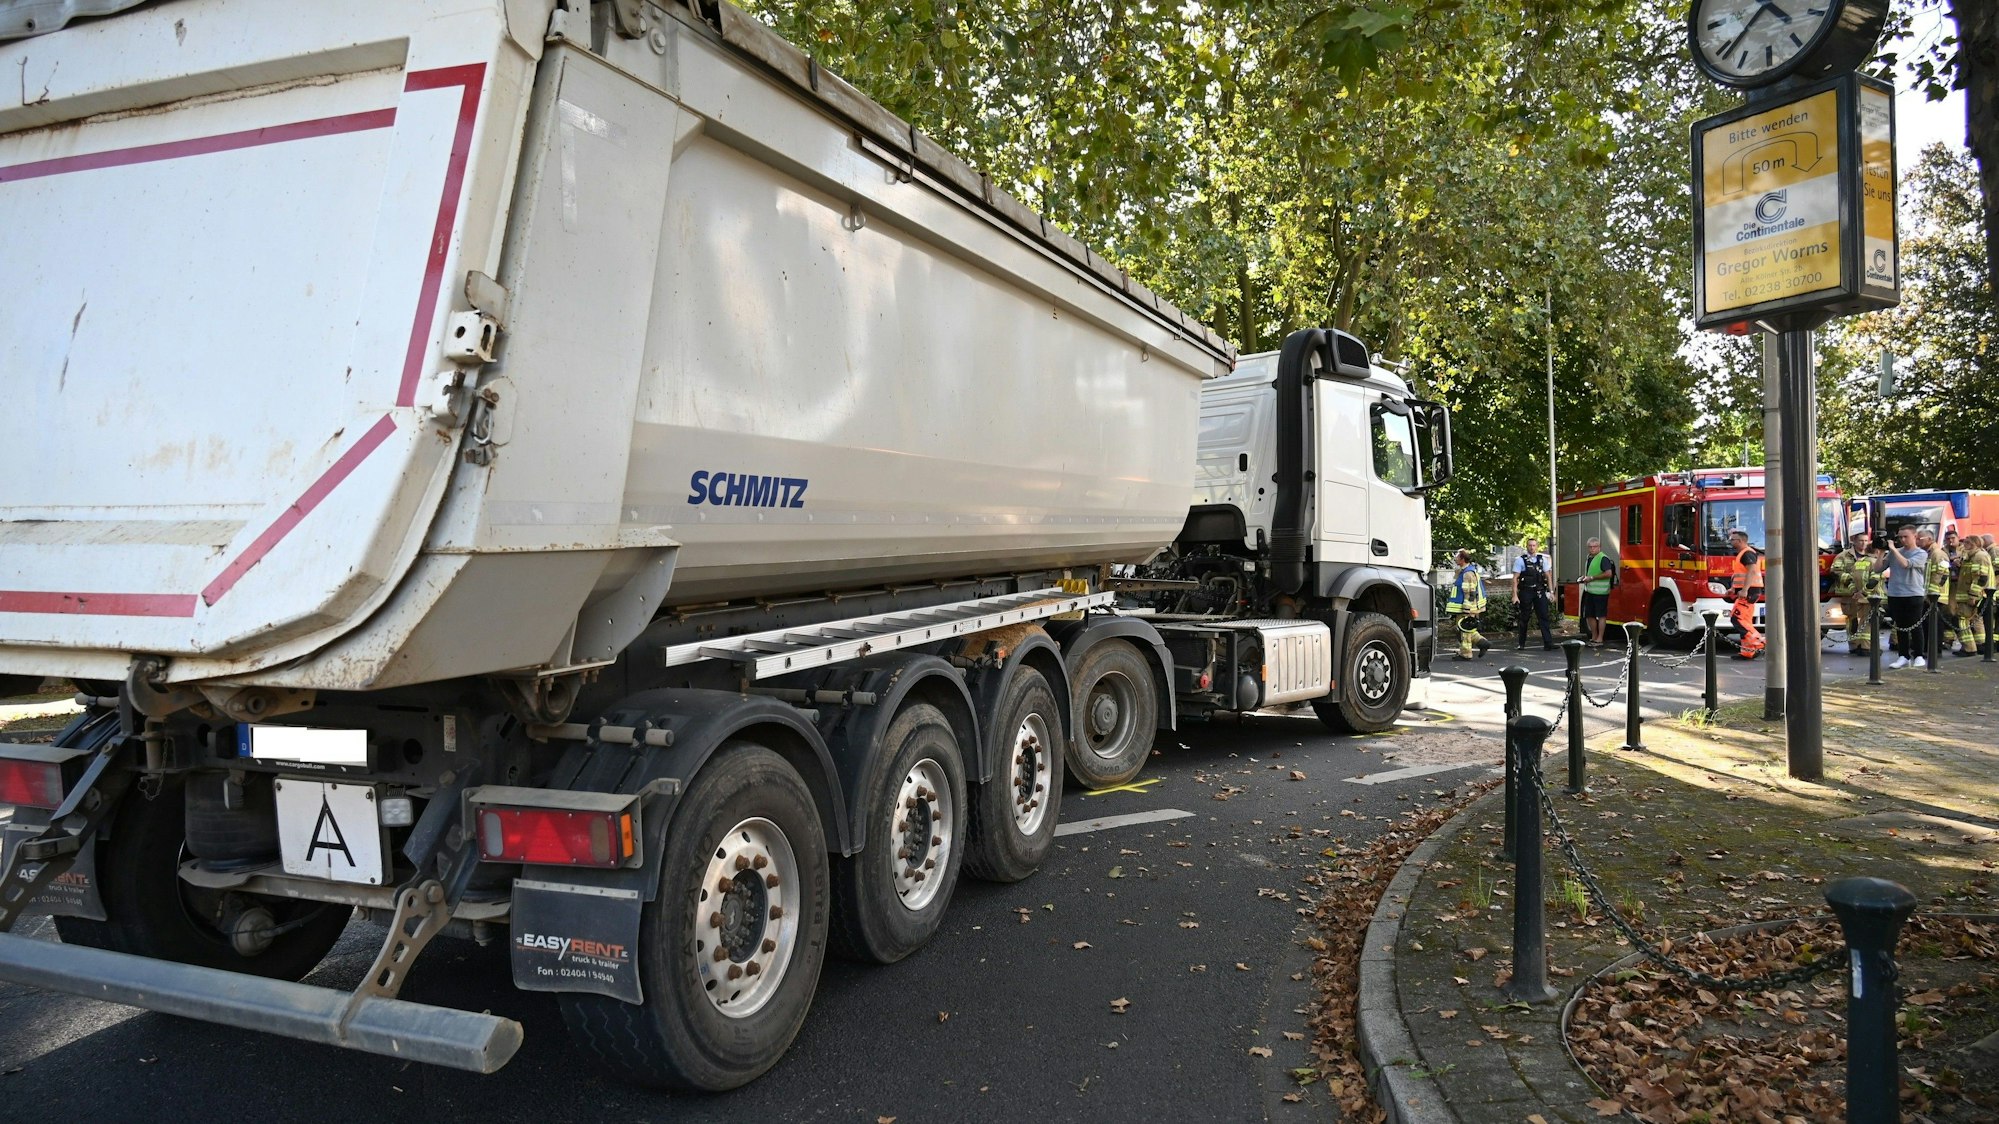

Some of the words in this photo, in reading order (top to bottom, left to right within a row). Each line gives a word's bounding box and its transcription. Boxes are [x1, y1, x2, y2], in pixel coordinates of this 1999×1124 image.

[1729, 128, 1757, 144] Bitte
[1761, 112, 1809, 133] wenden
[1752, 159, 1770, 175] 50
[1773, 157, 1785, 169] m
[1865, 160, 1889, 180] Testen
[1864, 182, 1876, 197] Sie
[1877, 189, 1891, 202] uns
[1736, 217, 1805, 242] Continentale
[1743, 222, 1756, 231] Die
[1717, 255, 1767, 276] Gregor
[1772, 241, 1828, 263] Worms
[1723, 289, 1741, 302] Tel.
[1744, 280, 1781, 297] 02238
[1785, 271, 1822, 289] 30700
[687, 470, 809, 508] SCHMITZ
[275, 760, 326, 770] www.cargobull.com
[305, 795, 357, 867] A
[571, 955, 590, 964] truck
[598, 959, 620, 970] trailer
[537, 966, 554, 976] Fon
[560, 968, 587, 978] 02404
[592, 971, 615, 983] 94940
